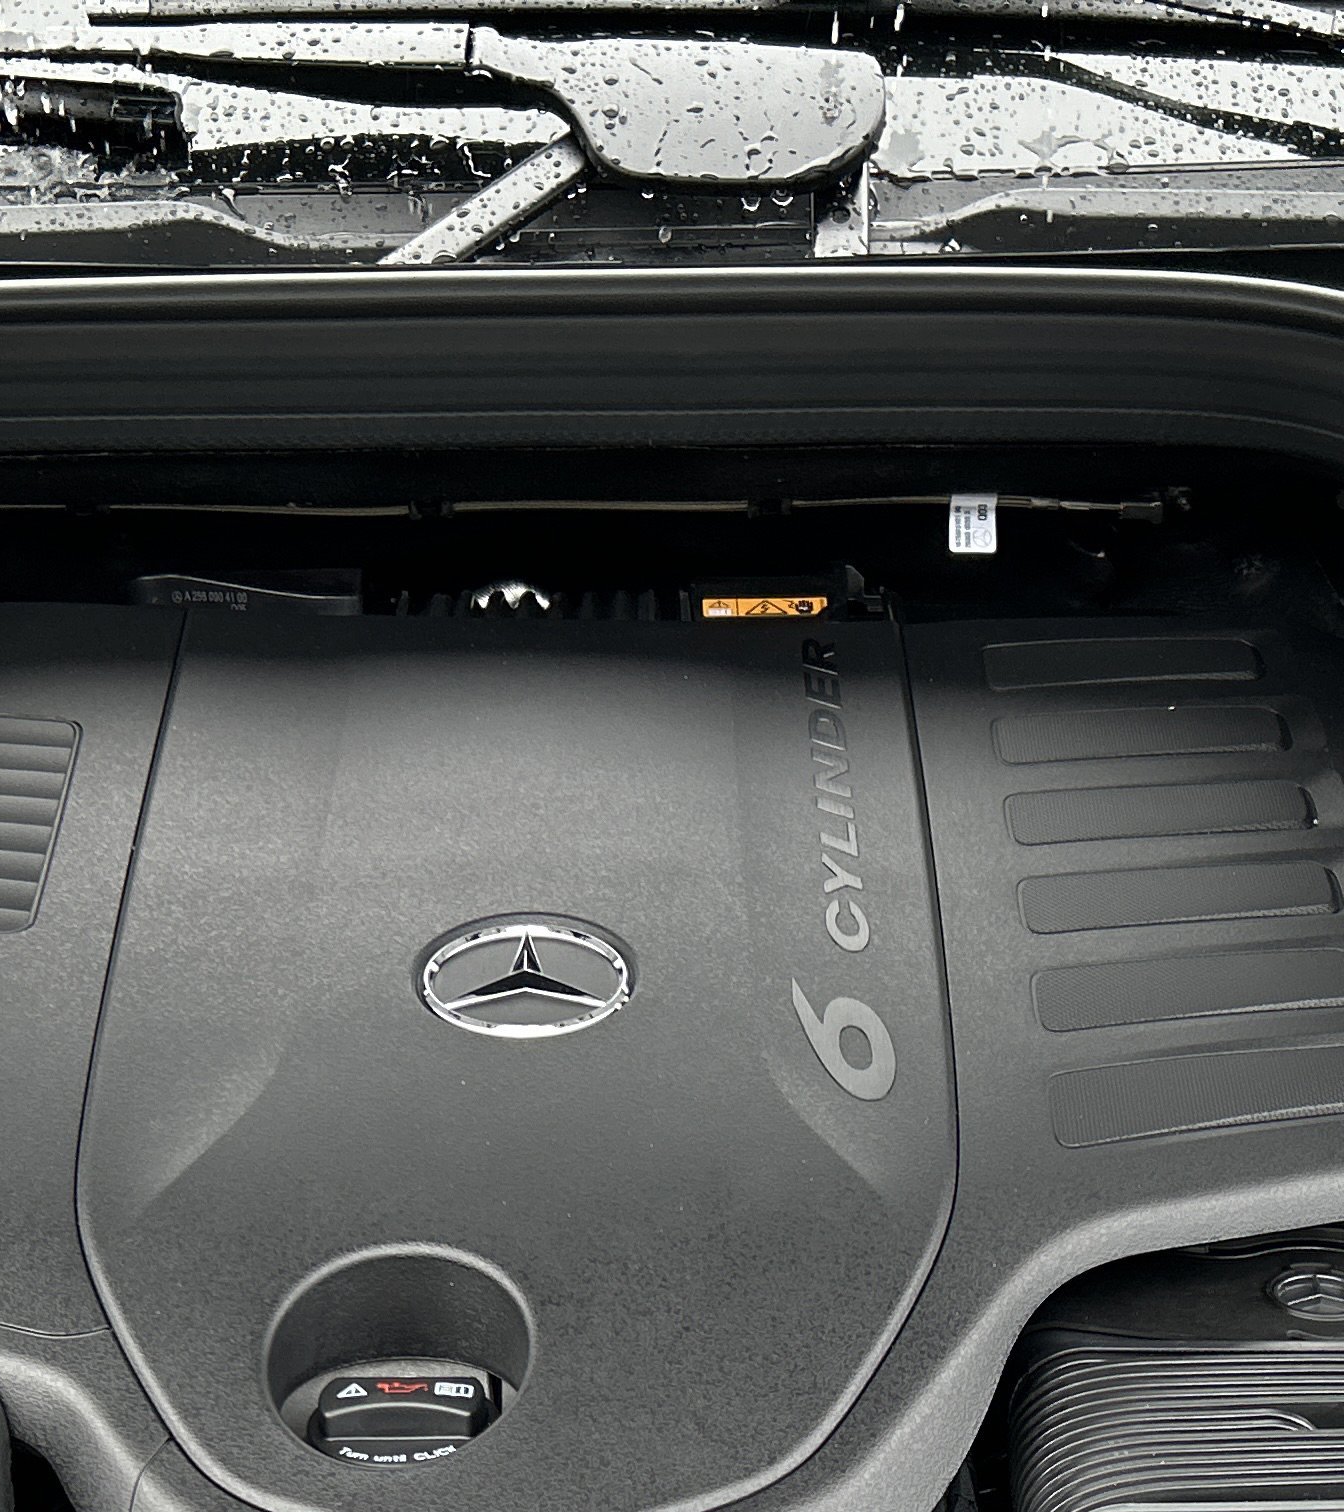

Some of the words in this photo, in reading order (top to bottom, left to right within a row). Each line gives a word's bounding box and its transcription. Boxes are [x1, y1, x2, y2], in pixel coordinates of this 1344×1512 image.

[802, 638, 870, 952] CYLINDER
[792, 977, 897, 1102] 6
[339, 1446, 369, 1461] Turn
[373, 1454, 407, 1462] until
[413, 1445, 457, 1461] CLICK
